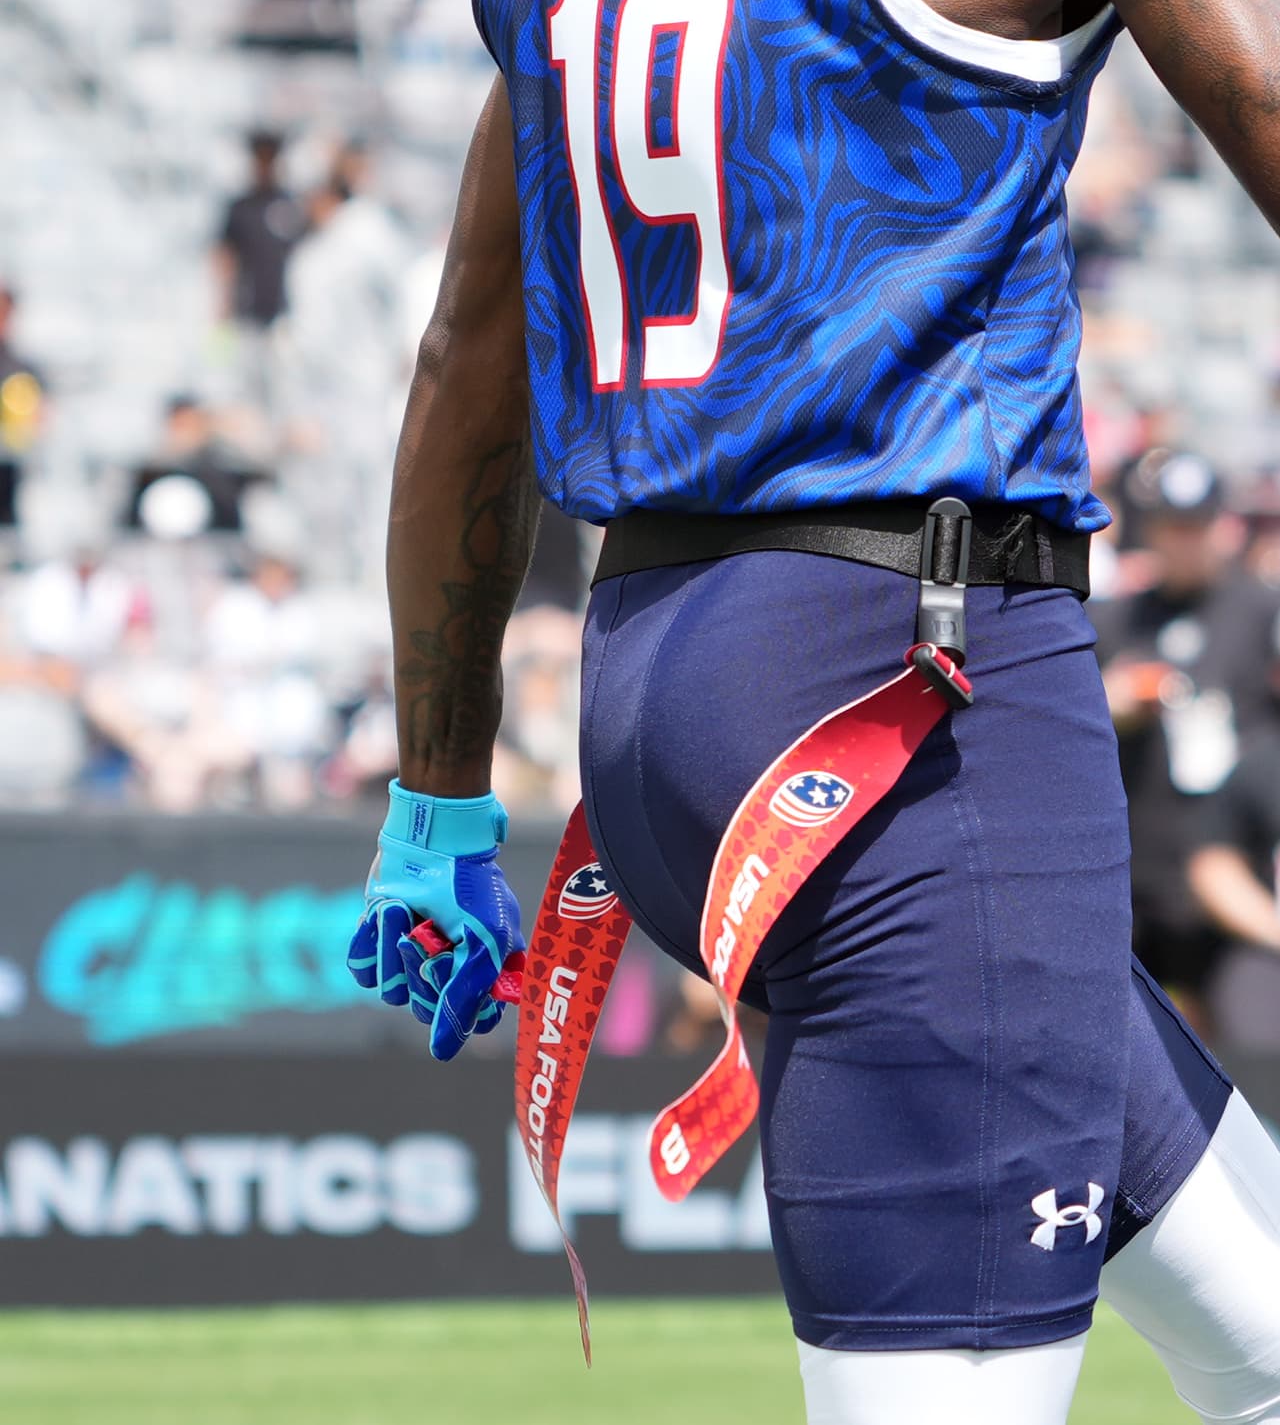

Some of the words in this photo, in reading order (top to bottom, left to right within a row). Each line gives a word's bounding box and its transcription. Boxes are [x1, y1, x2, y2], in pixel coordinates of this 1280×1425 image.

[411, 803, 421, 842] ARMOUR
[418, 803, 428, 836] UNDER
[725, 854, 770, 926] USA
[538, 966, 578, 1045] USA
[0, 1133, 478, 1238] NATICS
